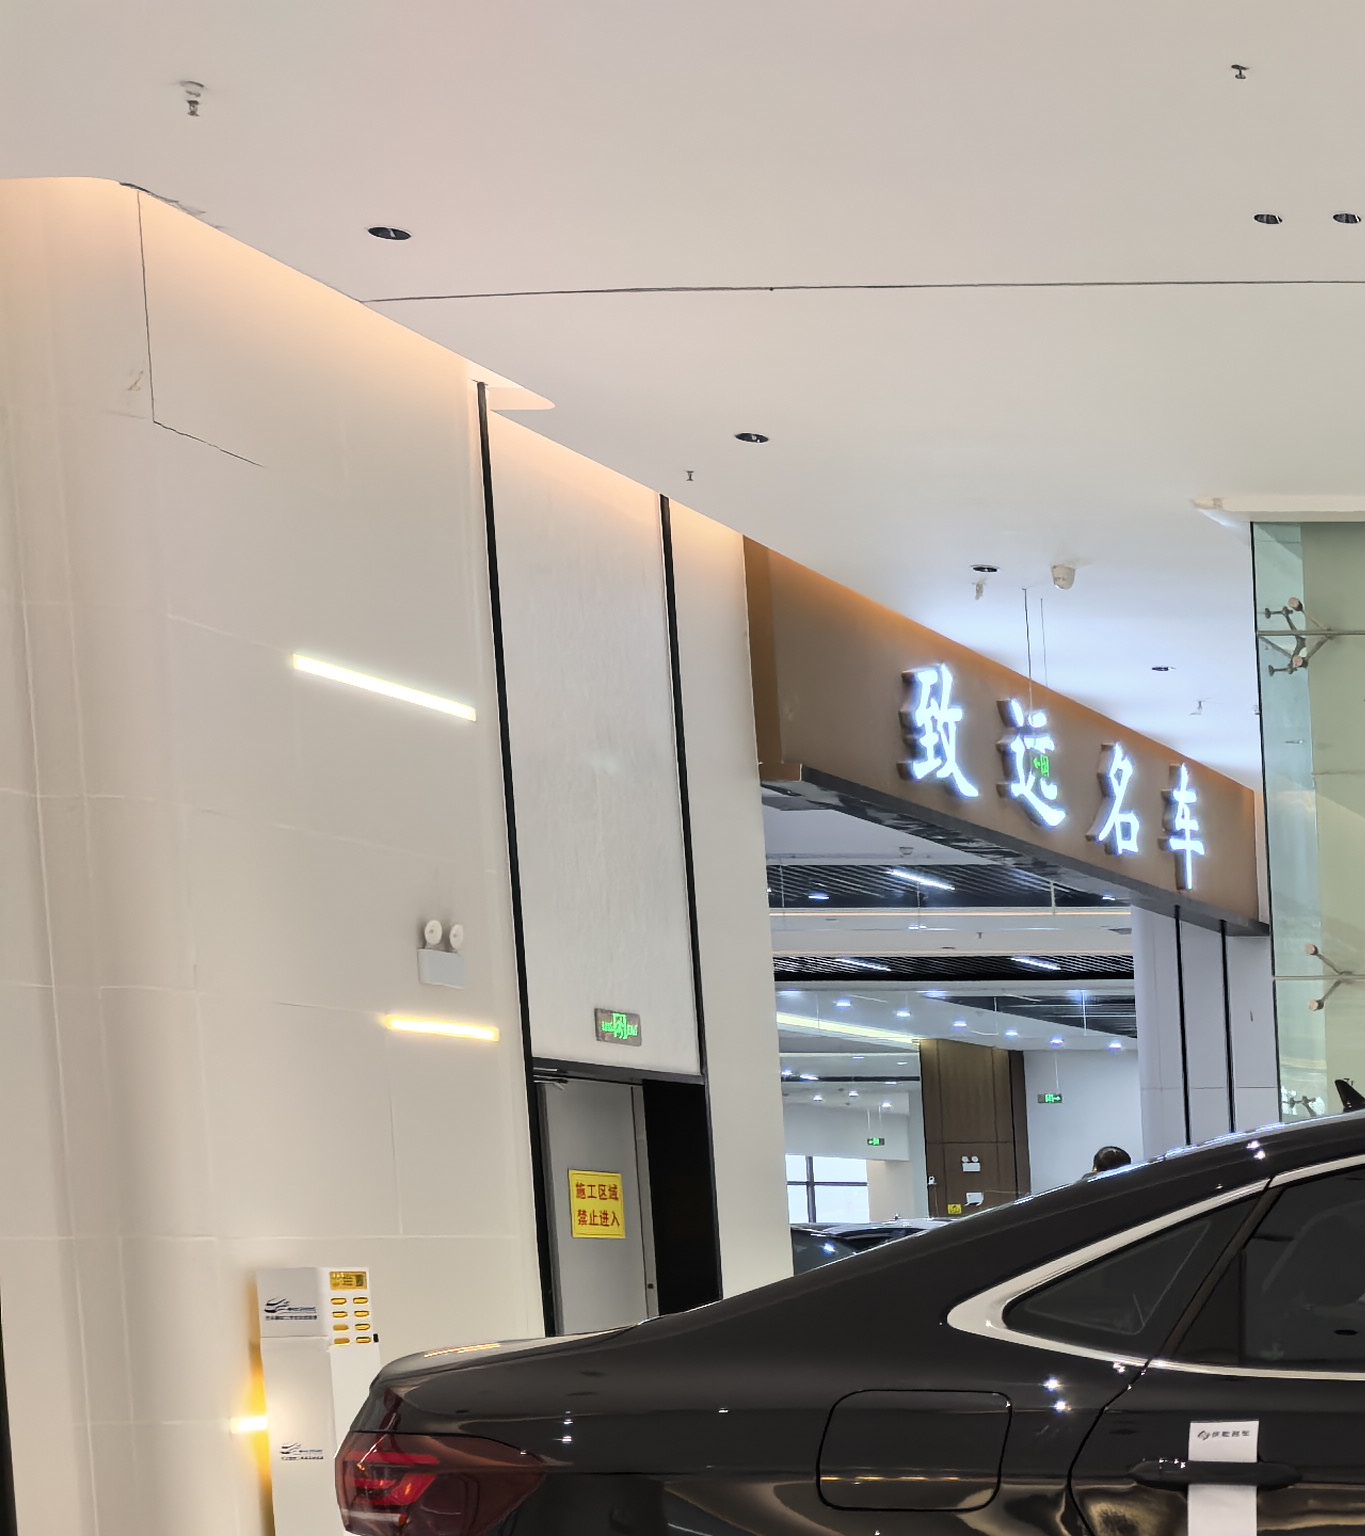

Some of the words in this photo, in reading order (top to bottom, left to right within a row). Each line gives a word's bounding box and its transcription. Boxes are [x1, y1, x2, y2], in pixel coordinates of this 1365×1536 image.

[576, 1182, 619, 1201] 施工区域
[578, 1208, 620, 1227] 禁止进入
